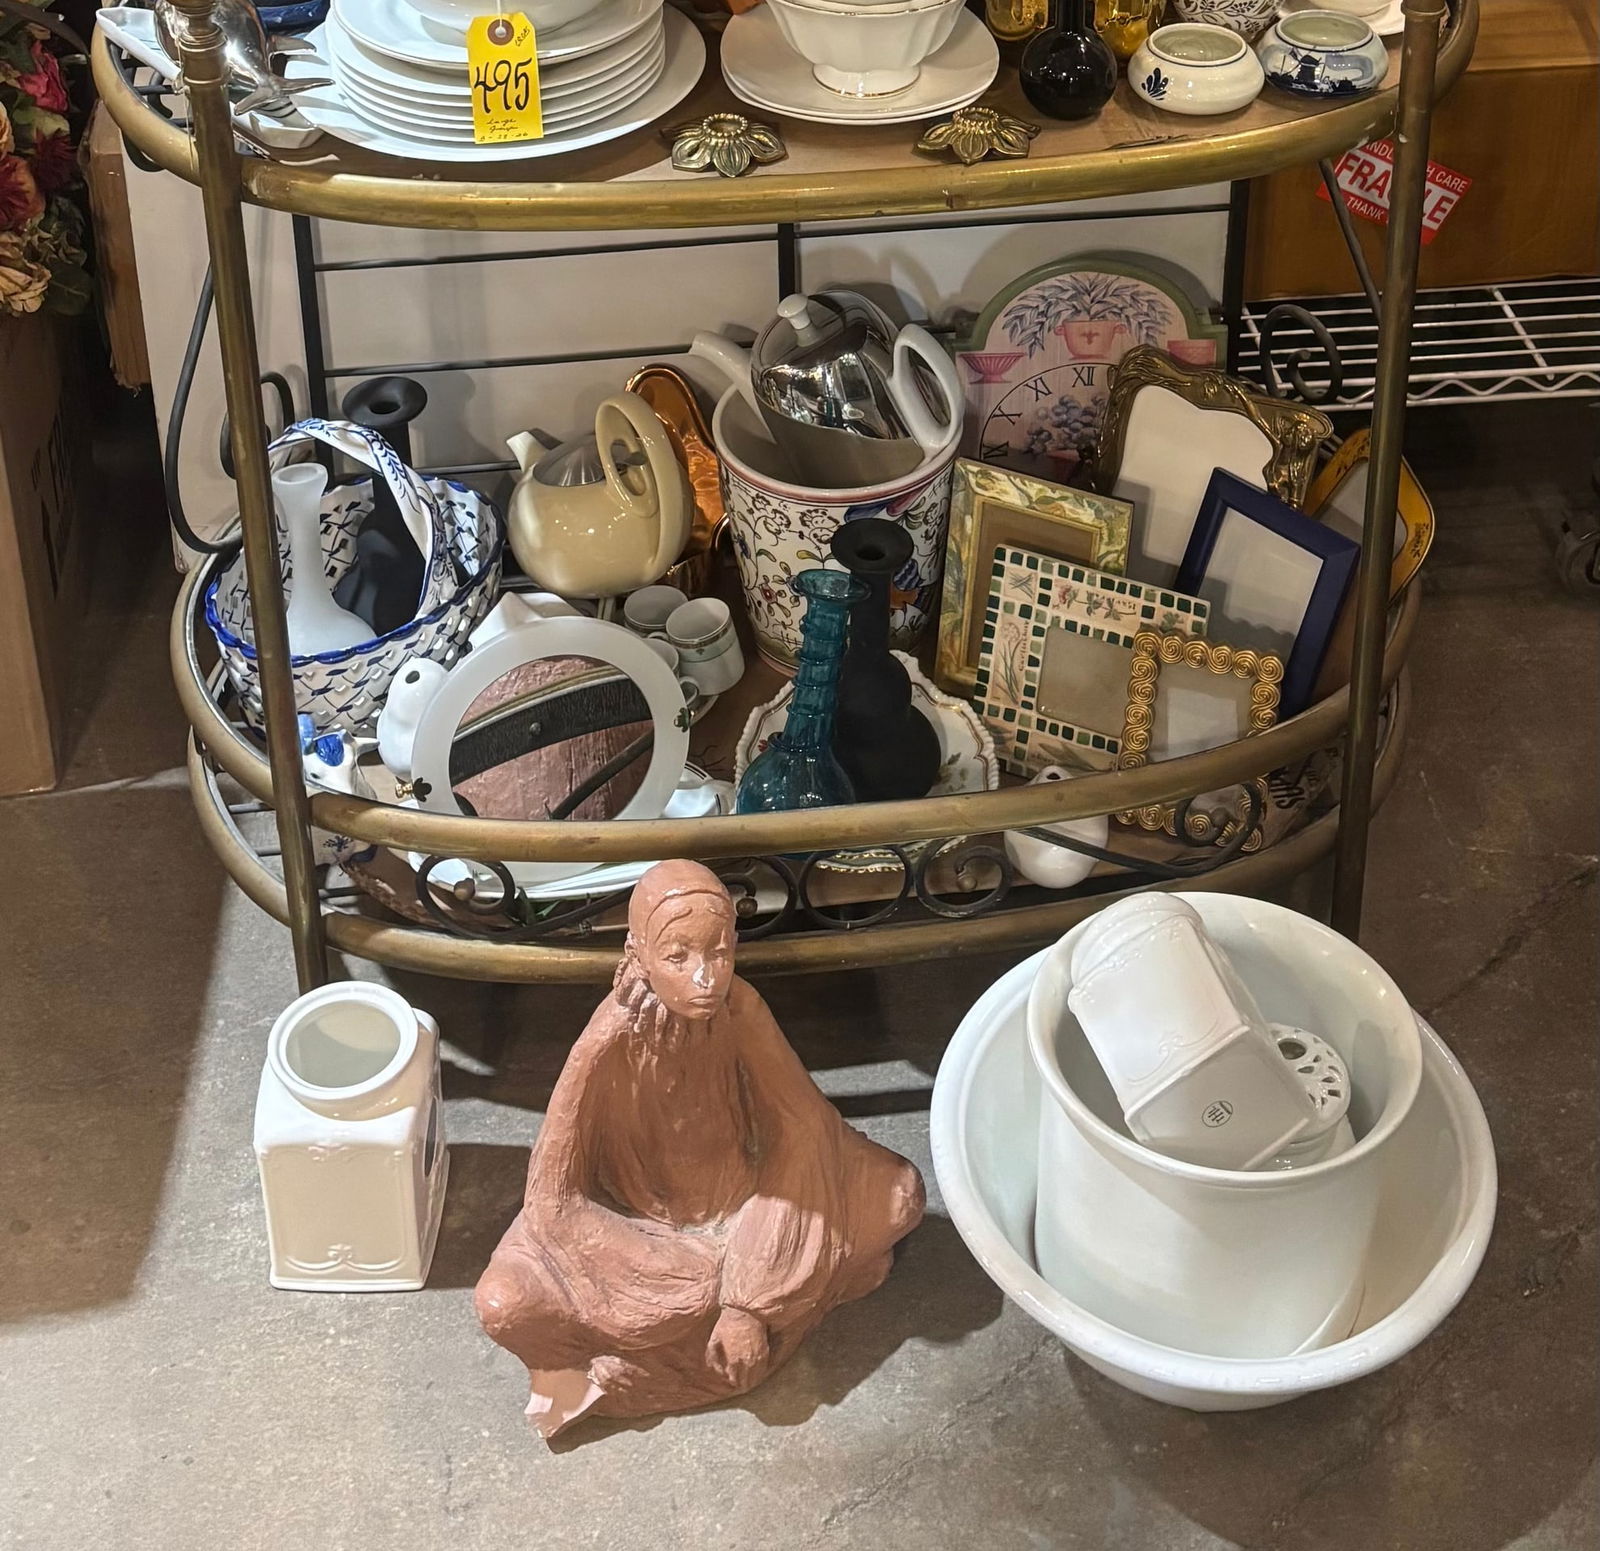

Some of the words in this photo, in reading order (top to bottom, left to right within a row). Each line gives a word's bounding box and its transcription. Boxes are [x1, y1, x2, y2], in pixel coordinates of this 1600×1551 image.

[474, 57, 532, 114] 495
[1436, 170, 1468, 193] CARE
[1347, 197, 1385, 221] THANK
[1072, 366, 1097, 388] XII
[1024, 376, 1053, 402] XI
[991, 406, 1023, 426] X
